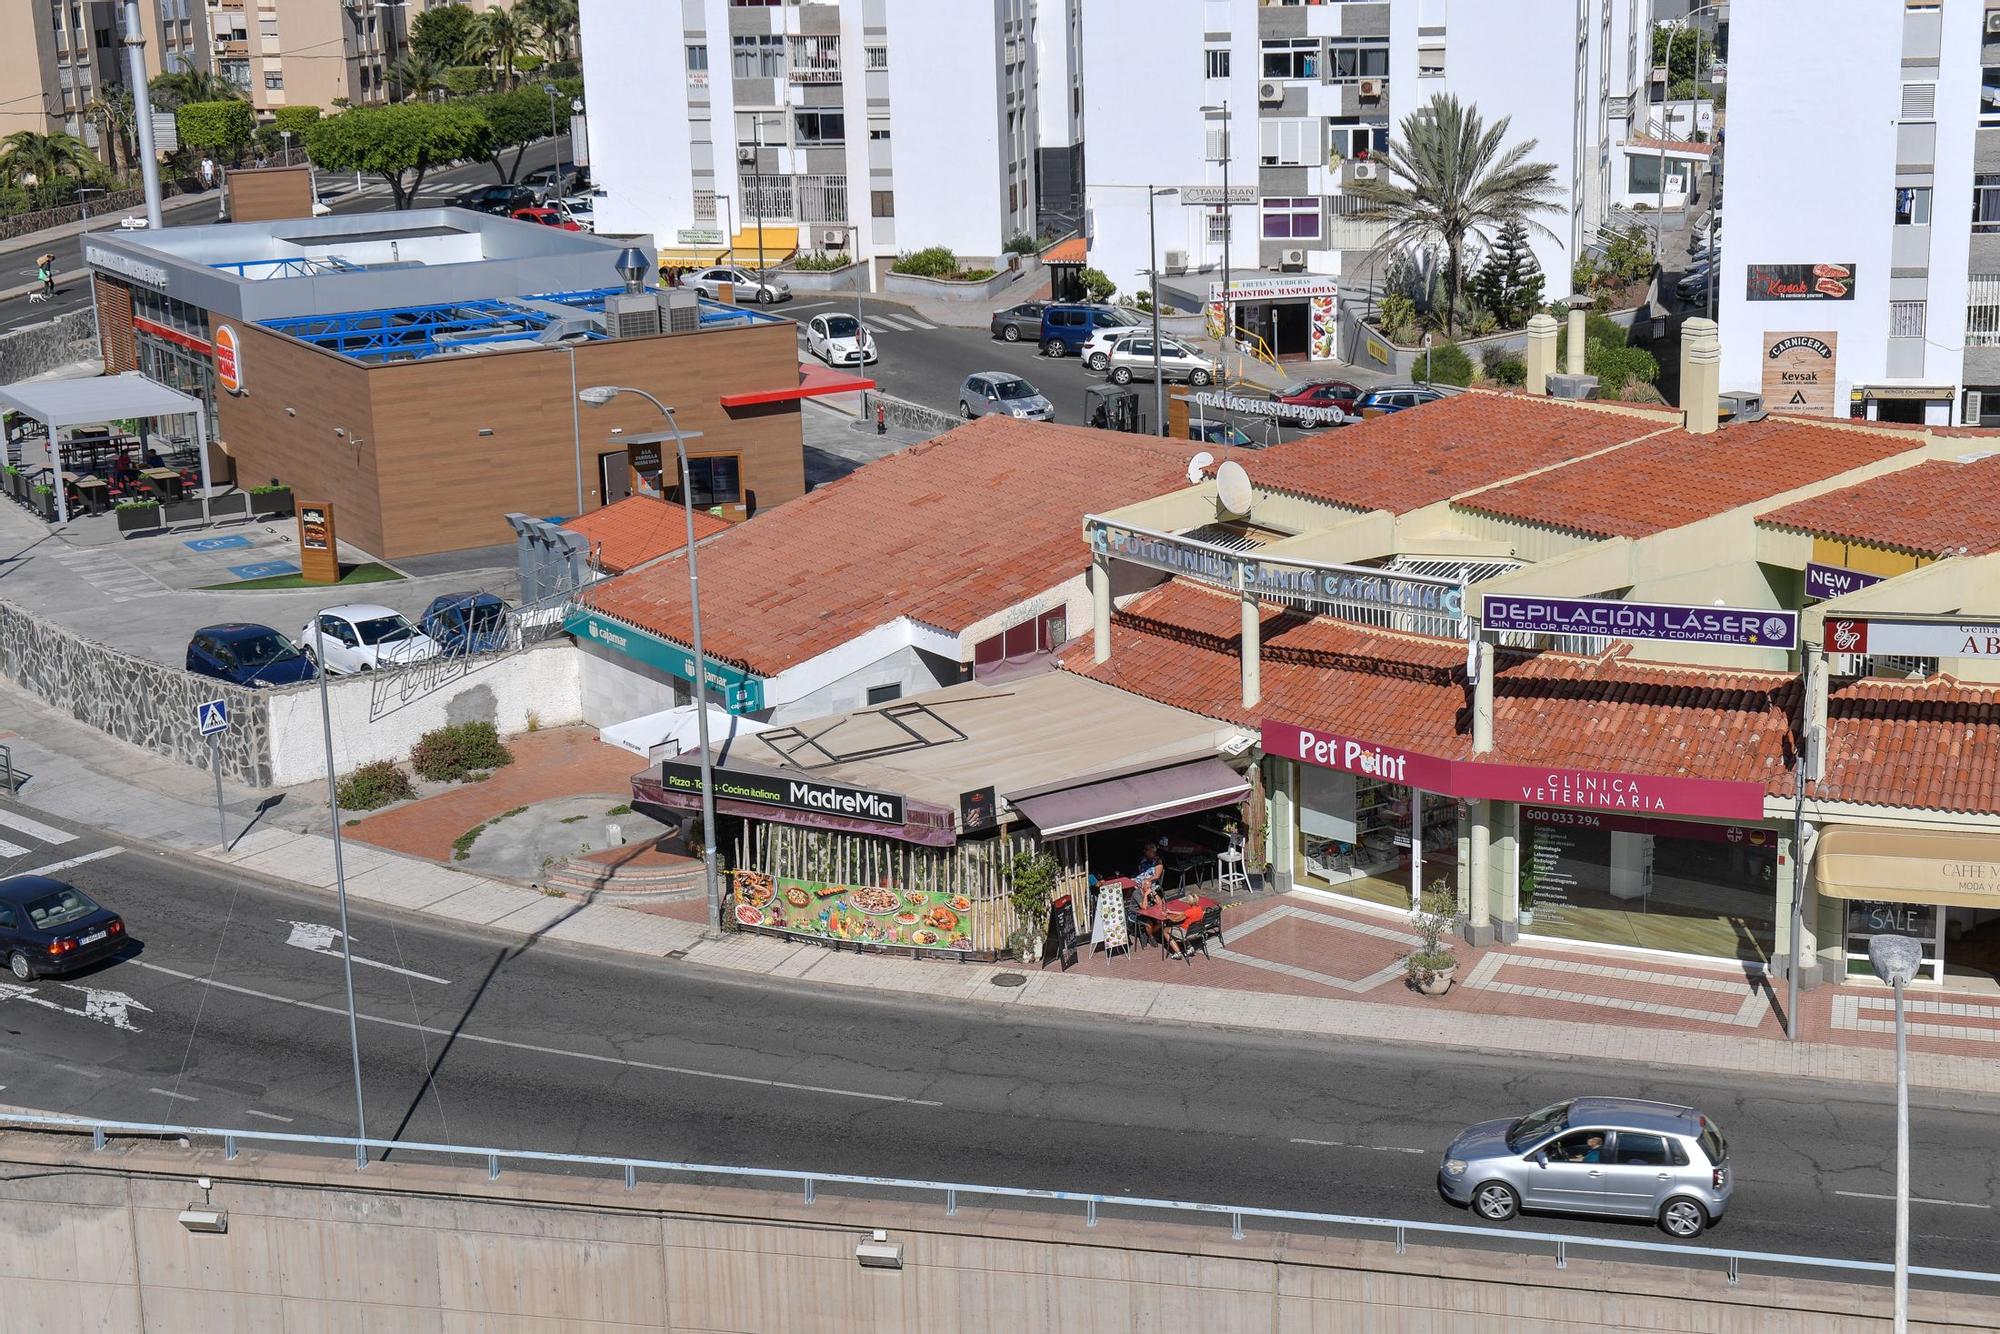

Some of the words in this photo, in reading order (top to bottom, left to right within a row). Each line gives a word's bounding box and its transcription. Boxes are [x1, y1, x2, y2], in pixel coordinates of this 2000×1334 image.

[1200, 188, 1254, 196] TAMARAN
[1278, 286, 1336, 296] MASPALOMAS
[1782, 371, 1817, 381] Kevsak
[1196, 391, 1249, 414] GRACIAS,
[1250, 400, 1292, 418] HASTA
[1292, 405, 1345, 423] PRONTO
[1244, 565, 1316, 592] SANTA
[1324, 576, 1437, 609] CATALINA
[1811, 569, 1851, 590] NEW
[1489, 602, 1655, 627] DEPILACIÓN
[1664, 610, 1760, 634] LÁSER
[600, 628, 627, 647] cajamar
[1490, 620, 1510, 628] SIN
[1612, 627, 1655, 638] EFICAZ
[1658, 629, 1666, 638] Y
[1669, 630, 1747, 643] COMPATIBLE
[704, 667, 727, 687] jamar
[730, 699, 754, 710] cajamar
[1300, 731, 1338, 765] Pet
[669, 775, 690, 788] Pizza
[694, 778, 718, 791] Tas
[722, 783, 750, 796] Cocina
[750, 786, 780, 801] italiana
[1547, 773, 1639, 793] CLÍNICA
[790, 782, 893, 818] MadreMia
[1522, 787, 1665, 810] VETERINARIA
[1527, 809, 1549, 821] 600
[1551, 811, 1574, 824] 033
[1577, 814, 1600, 827] 294
[1959, 881, 1985, 891] MODA
[1988, 883, 1994, 891] Y
[1868, 908, 1918, 932] SALE
